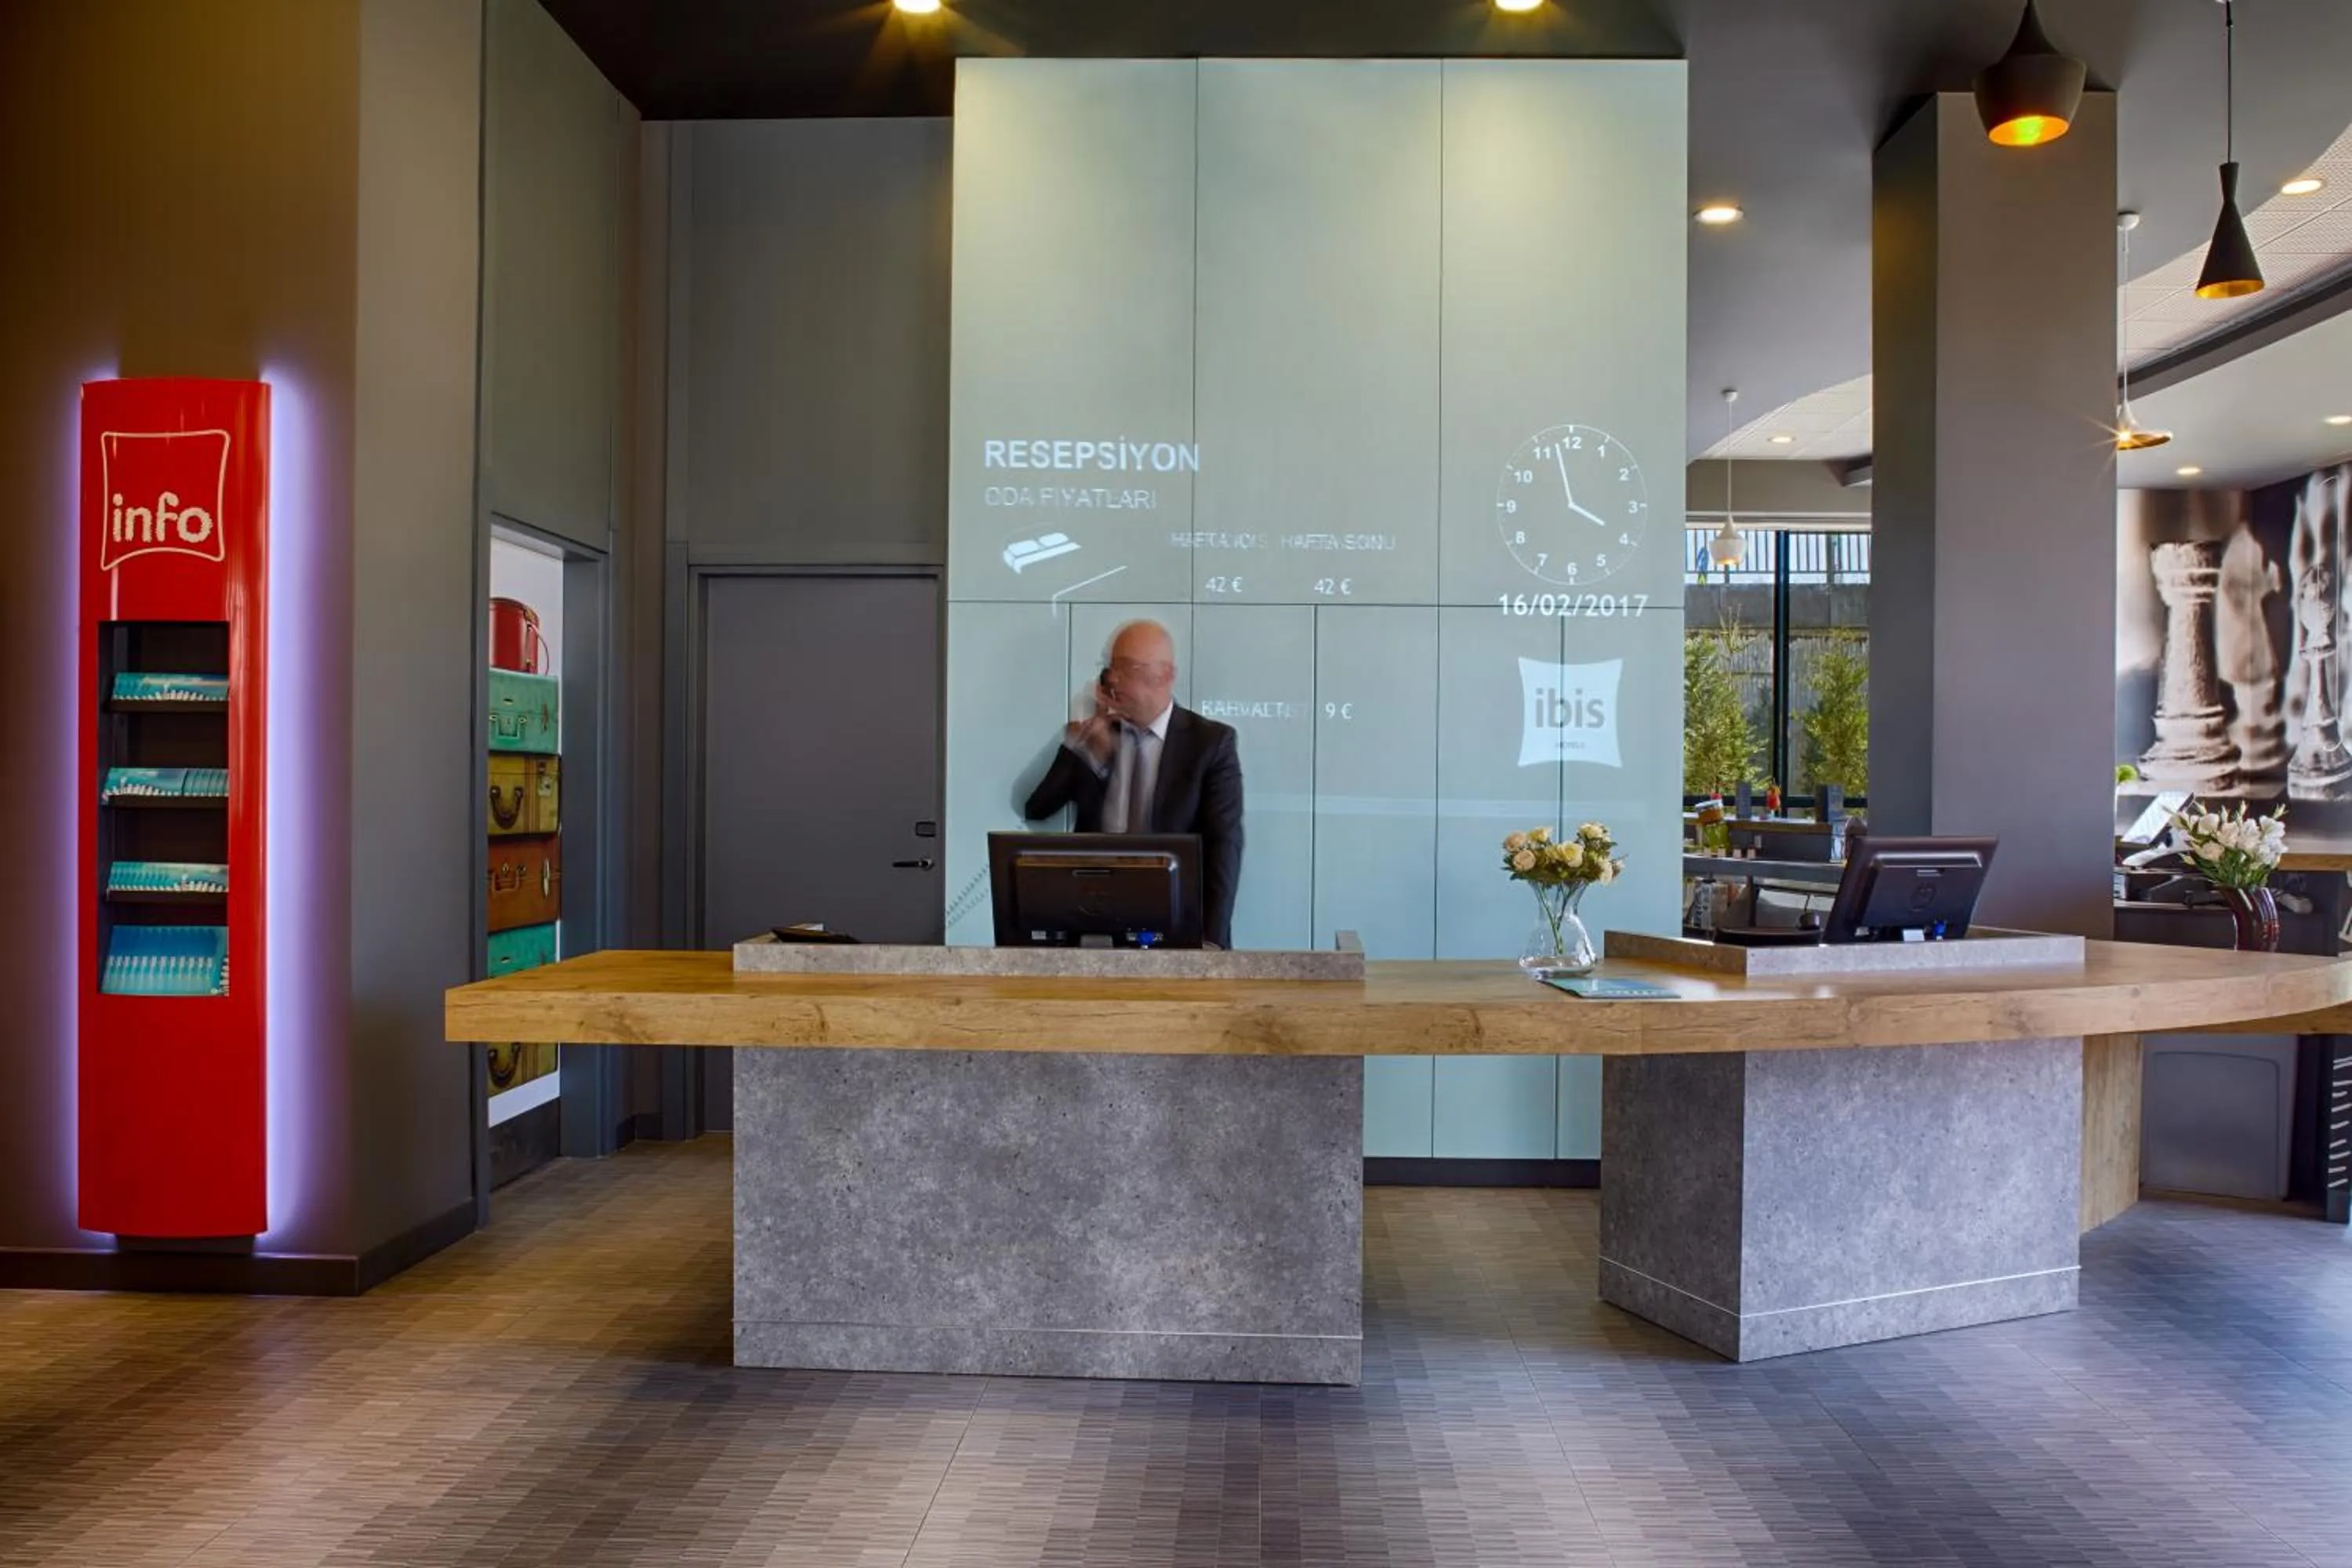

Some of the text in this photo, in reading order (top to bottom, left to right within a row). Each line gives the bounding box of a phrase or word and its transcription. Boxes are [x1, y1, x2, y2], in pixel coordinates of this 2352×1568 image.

[1564, 436, 1581, 448] 12
[984, 435, 1200, 471] RESEPSİYON
[1534, 447, 1551, 459] 11
[1598, 445, 1606, 457] 1
[1515, 470, 1533, 483] 10
[1619, 468, 1629, 481] 2
[1506, 500, 1516, 514] 9
[1628, 501, 1638, 514] 3
[112, 491, 214, 543] info
[1515, 532, 1526, 544] 8
[1619, 533, 1628, 545] 4
[1537, 554, 1548, 565] 7
[1596, 554, 1606, 567] 5
[1567, 563, 1577, 575] 6
[1205, 576, 1243, 593] 42 €
[1313, 578, 1352, 595] 42 €
[1498, 593, 1649, 617] 16/02/2017
[1325, 702, 1336, 717] 9
[1534, 687, 1606, 729] ibis
